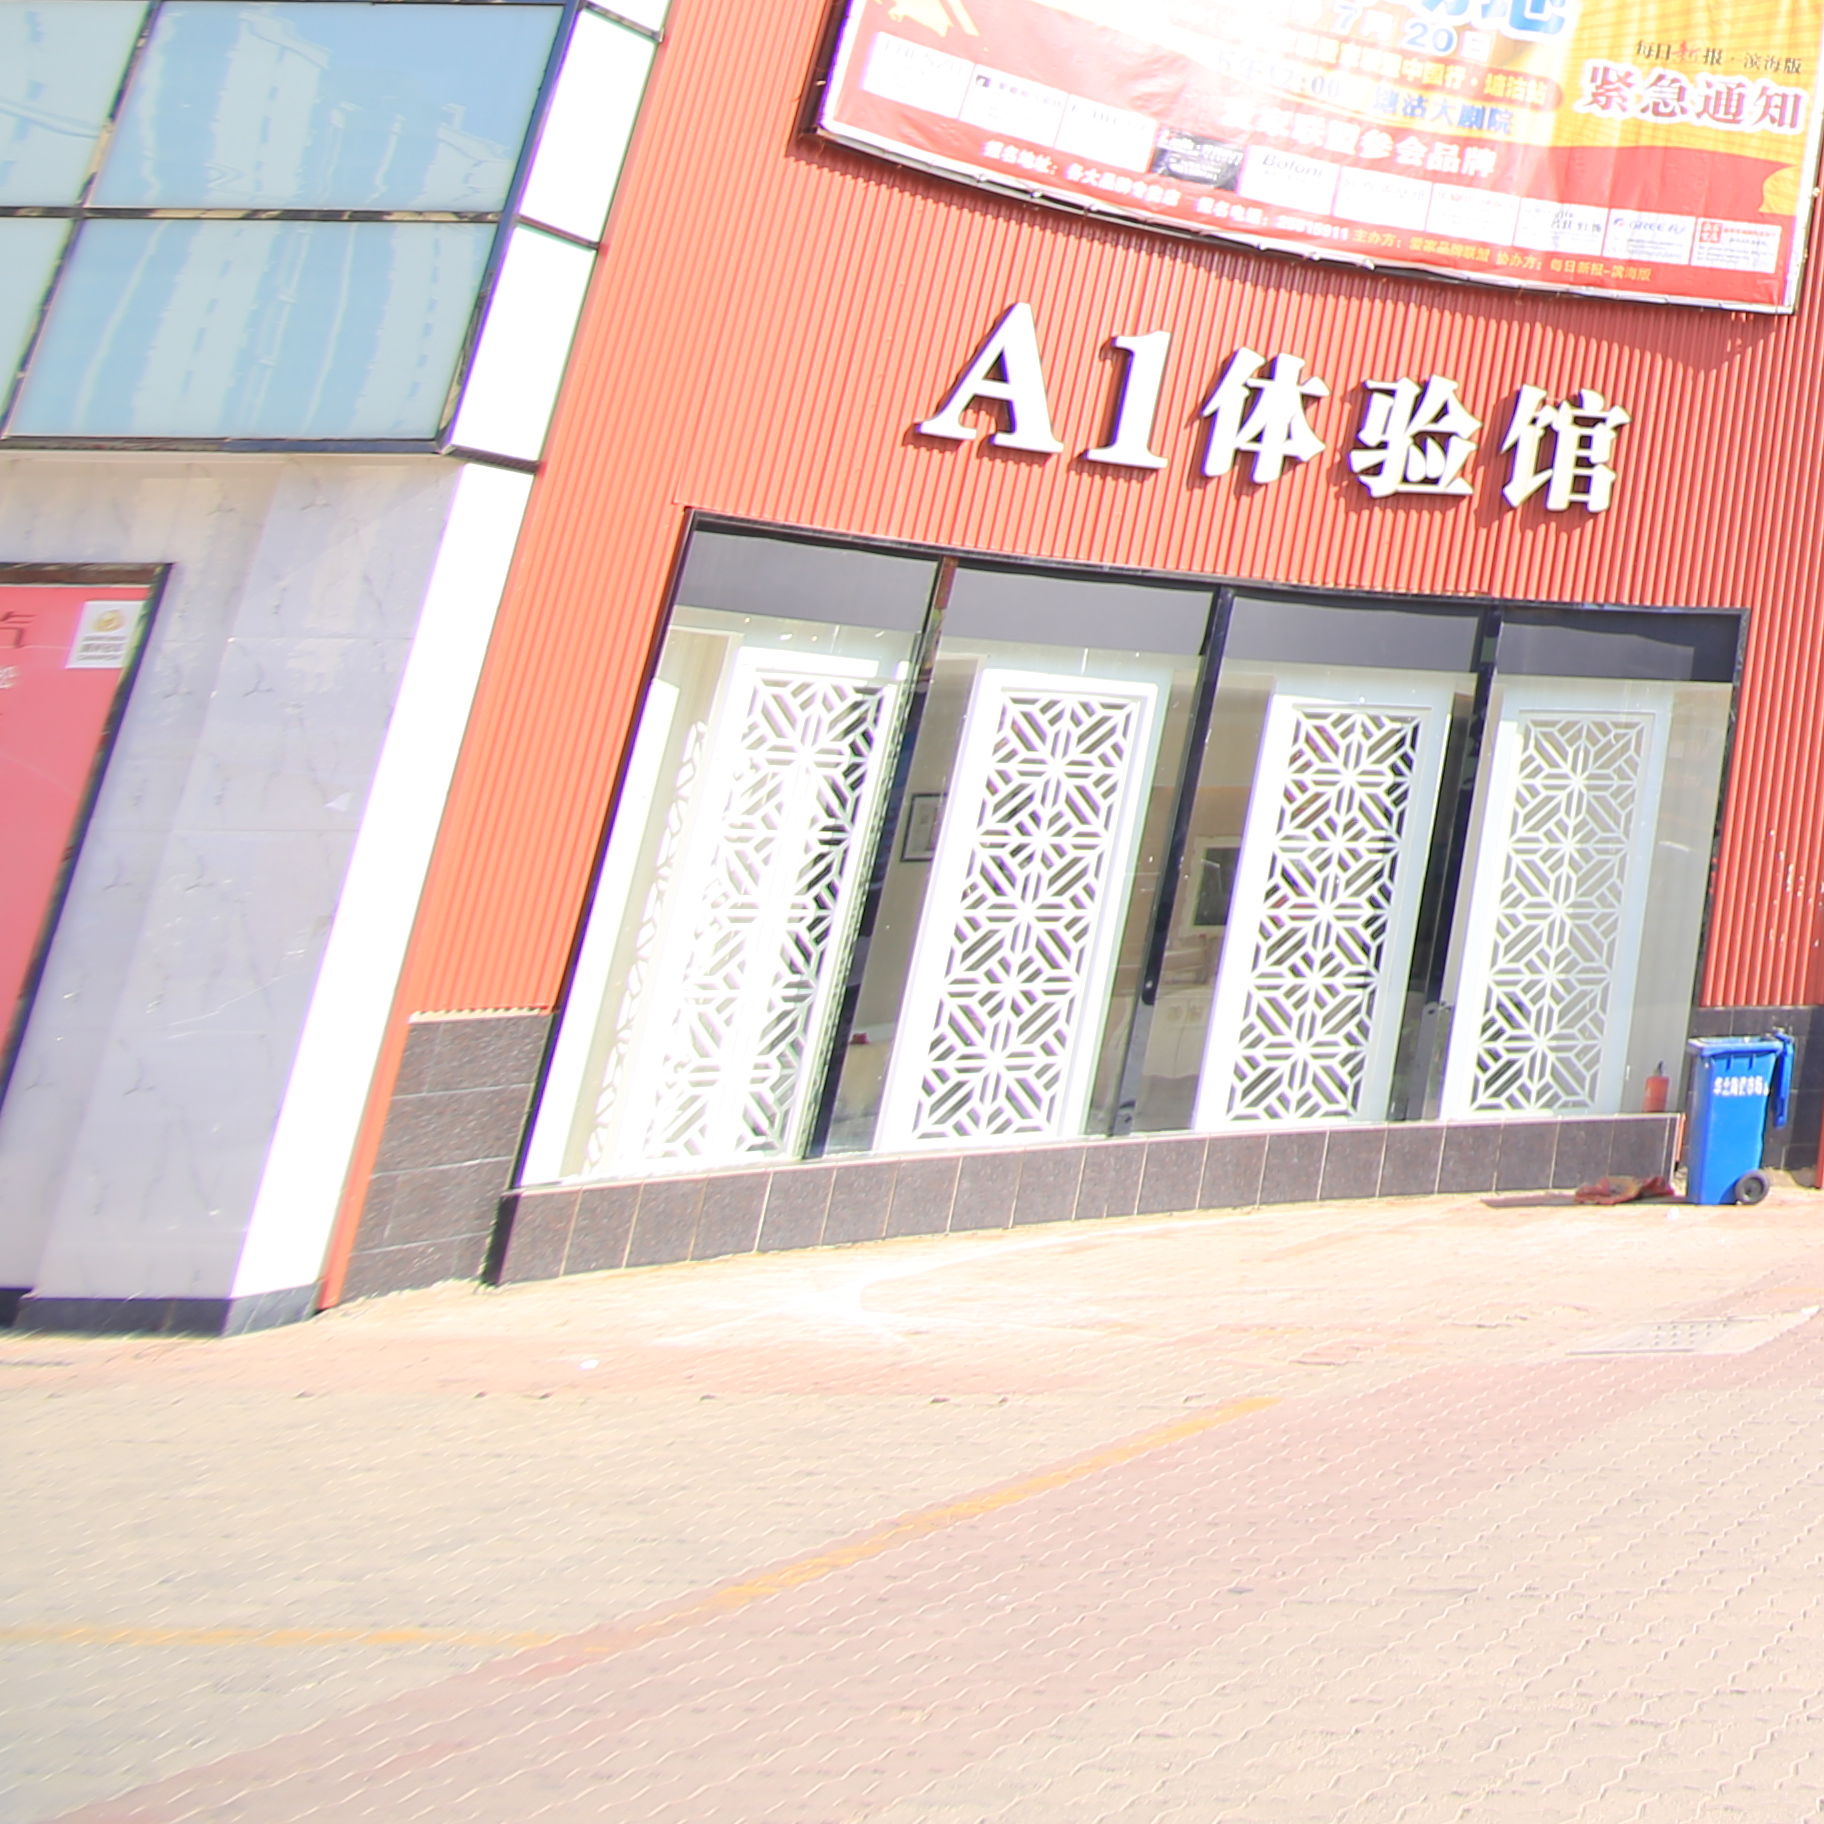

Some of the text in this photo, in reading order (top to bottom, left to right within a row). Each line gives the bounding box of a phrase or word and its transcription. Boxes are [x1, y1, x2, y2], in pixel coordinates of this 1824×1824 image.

[1583, 65, 1802, 130] 紧急通知
[915, 300, 1631, 515] A1体验馆
